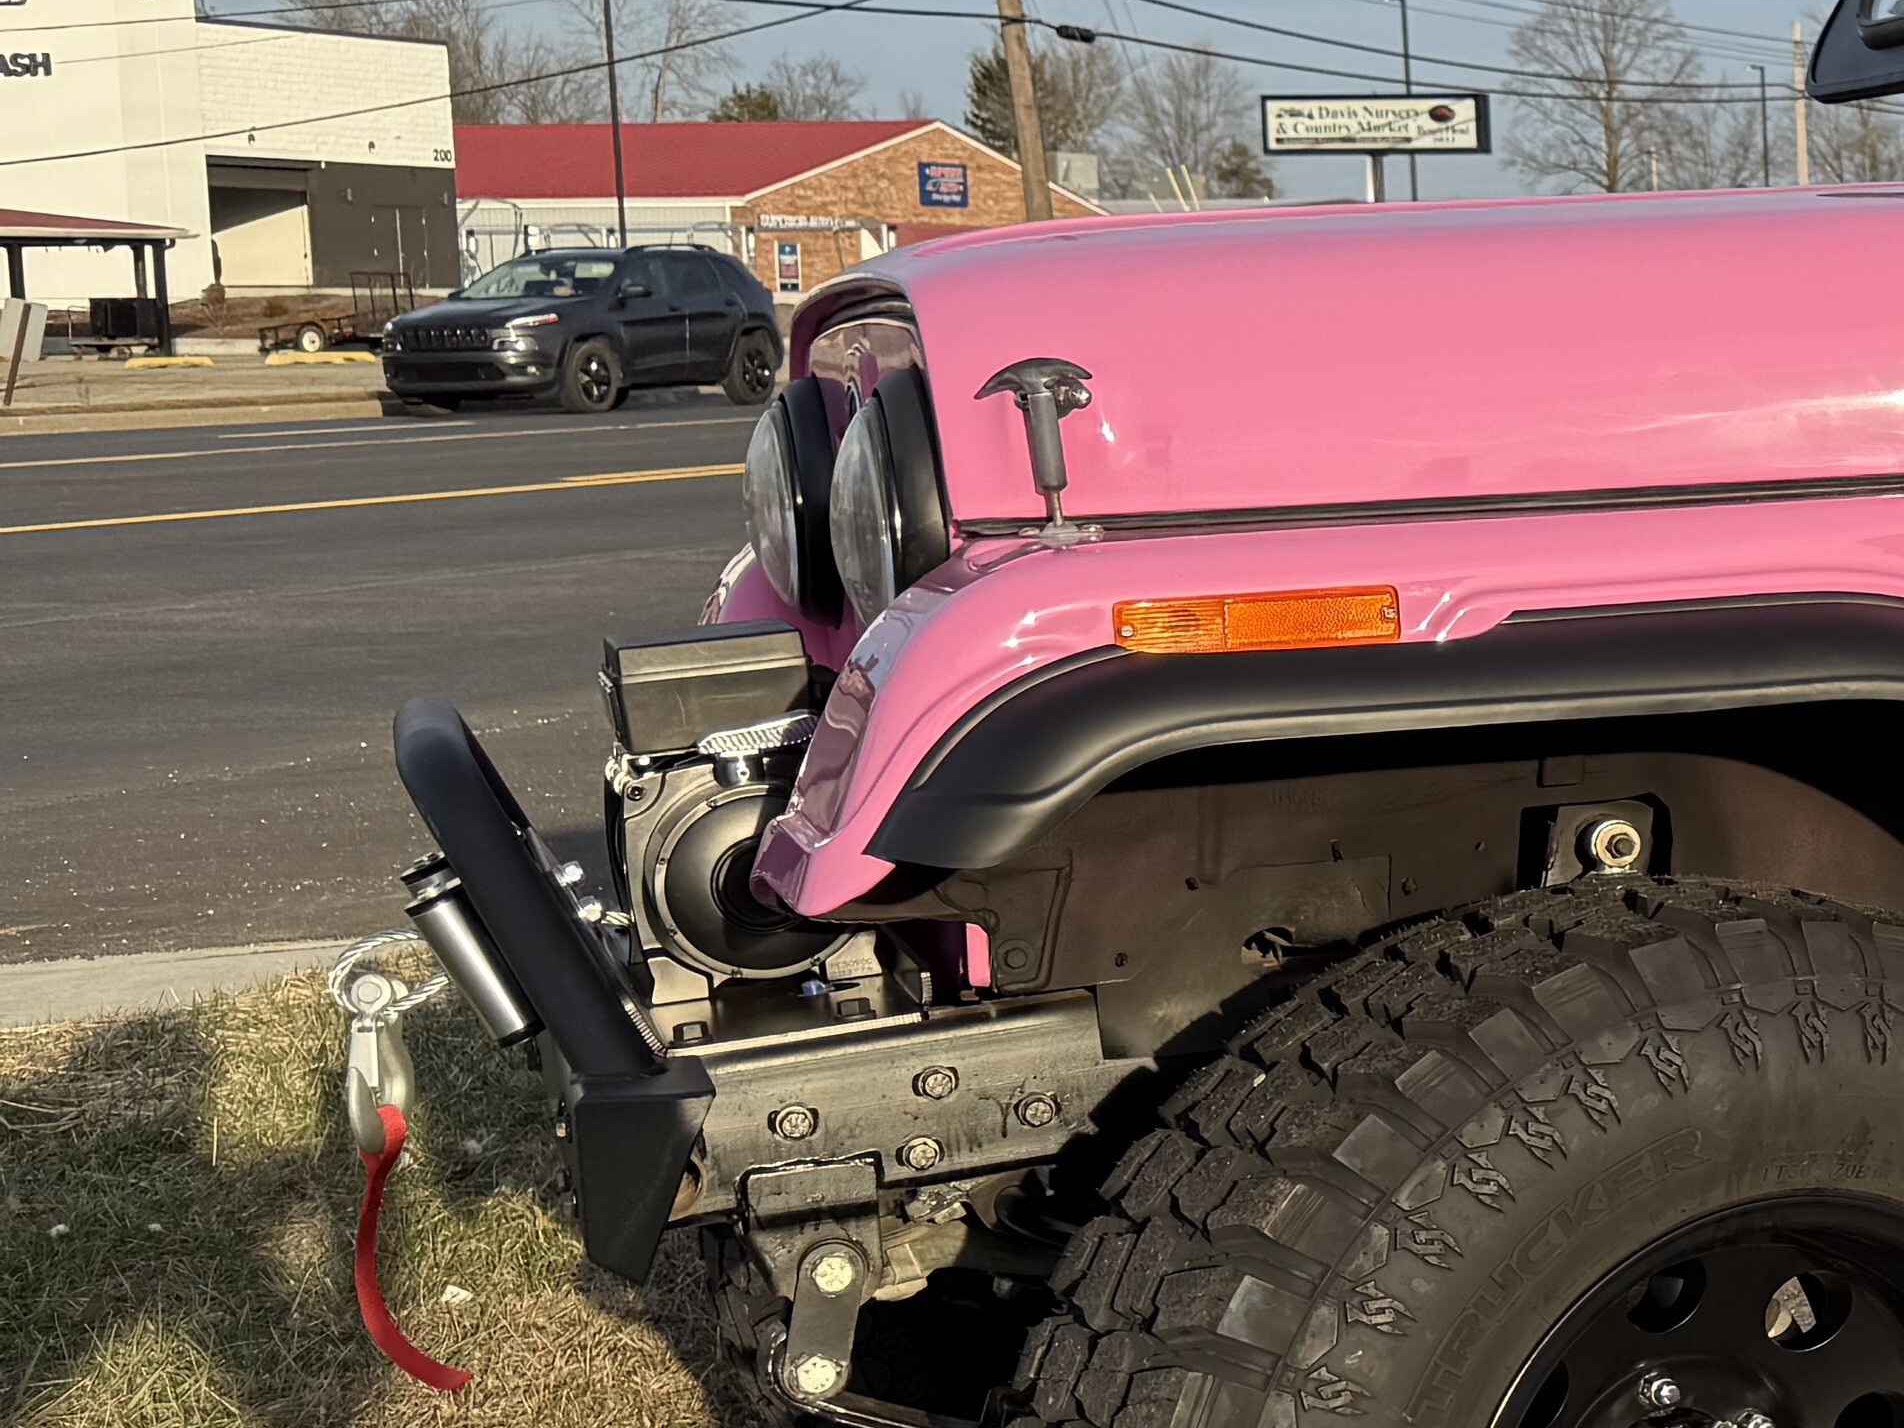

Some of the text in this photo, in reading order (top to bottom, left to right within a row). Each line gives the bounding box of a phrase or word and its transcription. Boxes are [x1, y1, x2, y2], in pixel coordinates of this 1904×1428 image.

[1317, 105, 1419, 122] Davis Nursery
[1292, 122, 1351, 136] Country
[1357, 121, 1410, 134] Market
[432, 148, 453, 162] 200
[1401, 1125, 1713, 1428] TRUCKER
